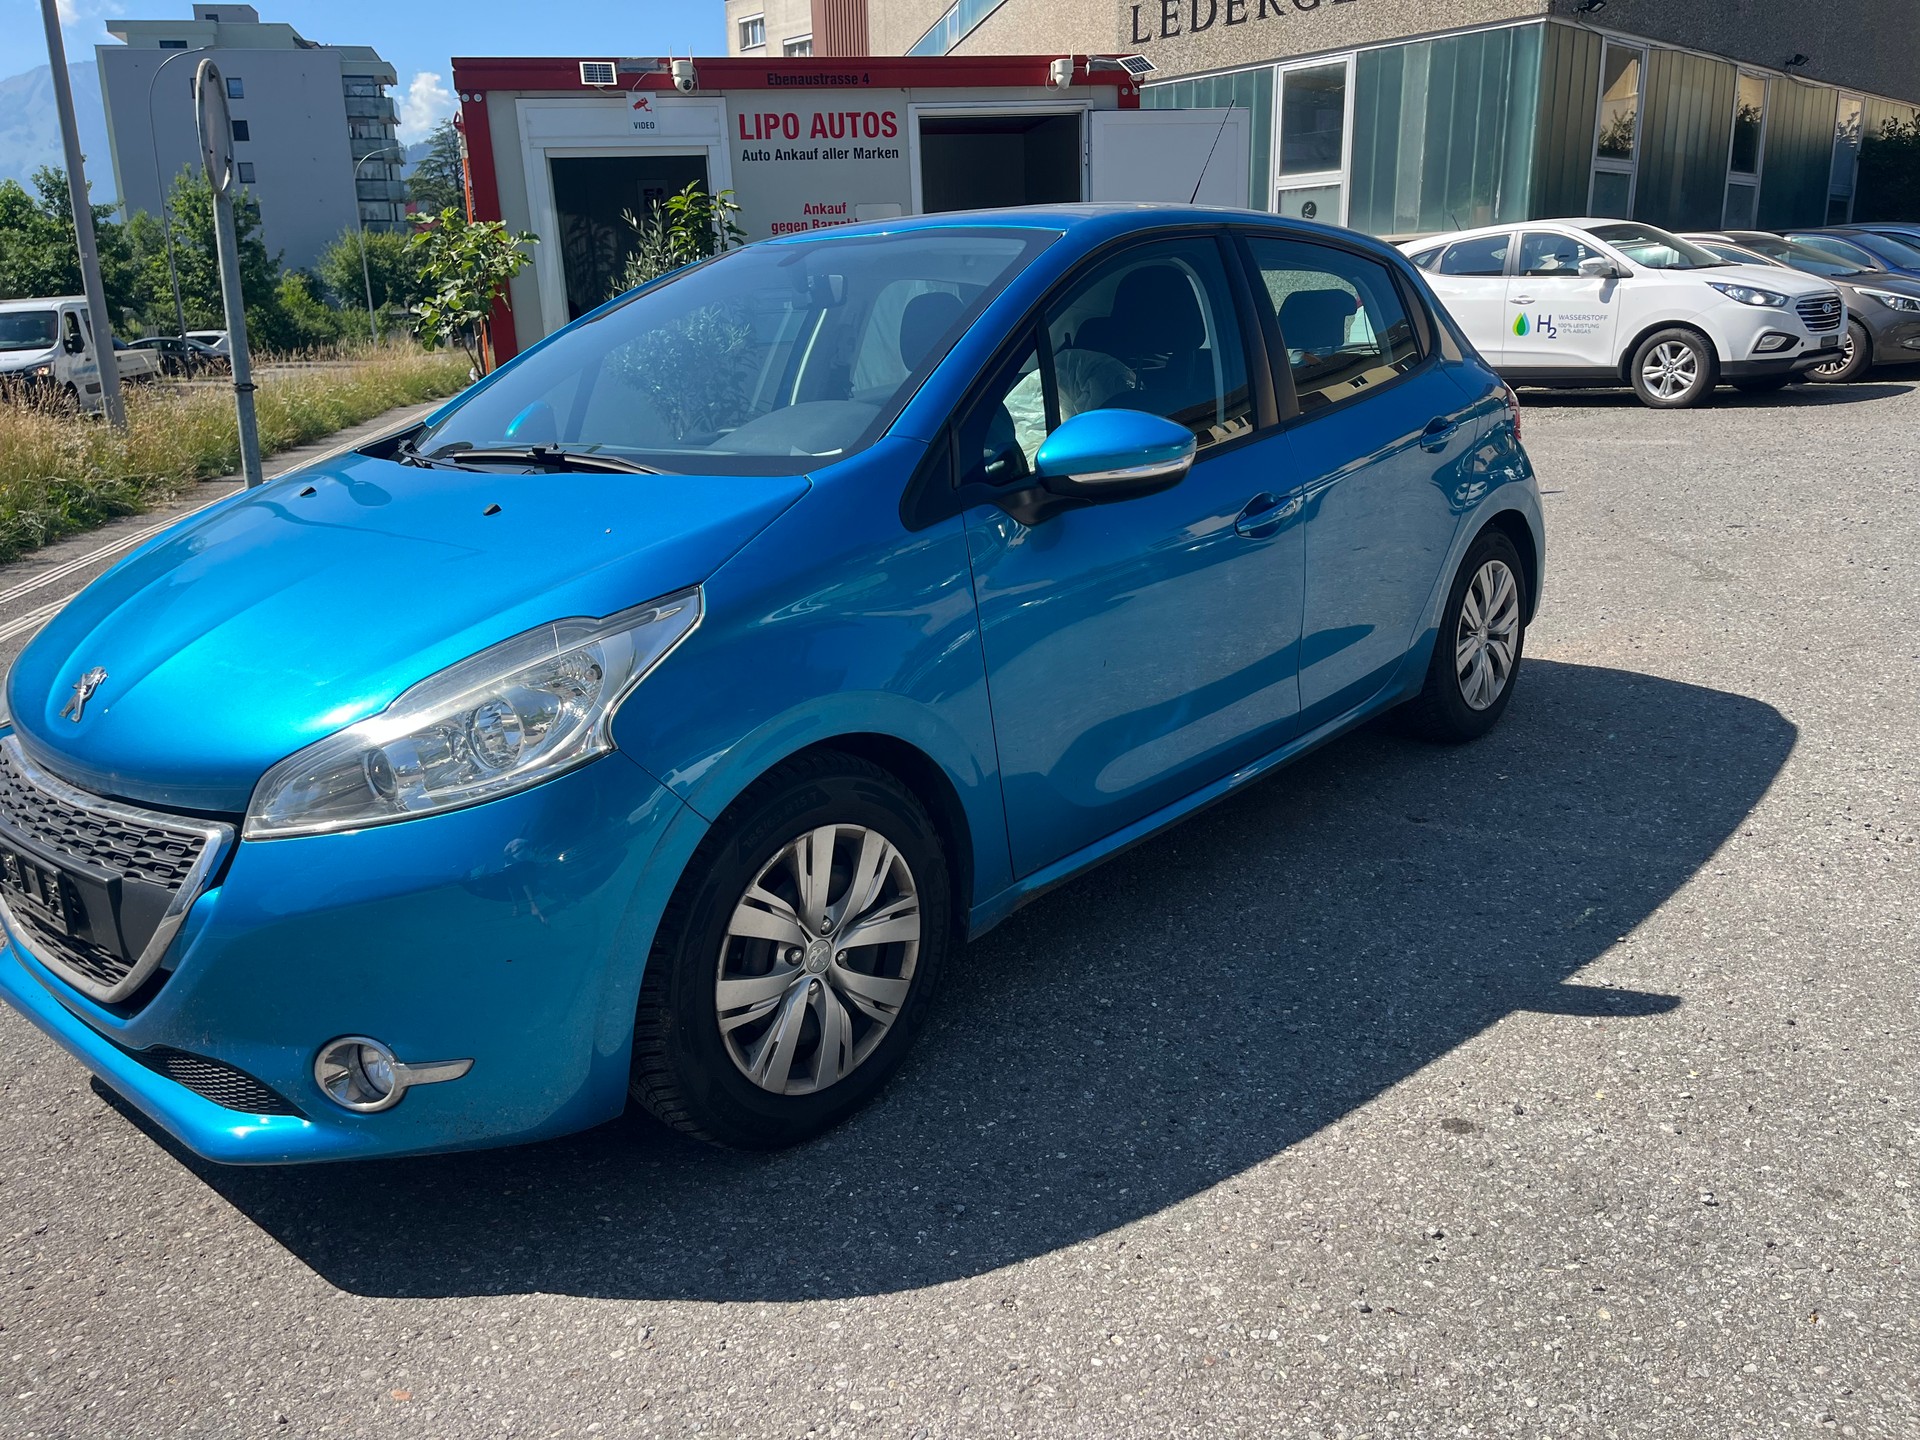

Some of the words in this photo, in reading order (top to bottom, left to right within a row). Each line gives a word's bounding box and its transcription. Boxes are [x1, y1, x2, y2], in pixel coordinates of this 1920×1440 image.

[767, 72, 858, 86] Ebenaustrasse
[862, 73, 870, 85] 4
[633, 121, 655, 130] VIDEO
[738, 112, 800, 141] LIPO
[809, 111, 898, 139] AUTOS
[742, 149, 771, 162] Auto
[774, 148, 818, 161] Ankauf
[822, 148, 849, 160] aller
[853, 147, 899, 160] Marken
[803, 202, 846, 215] Ankauf
[771, 221, 808, 235] gegen
